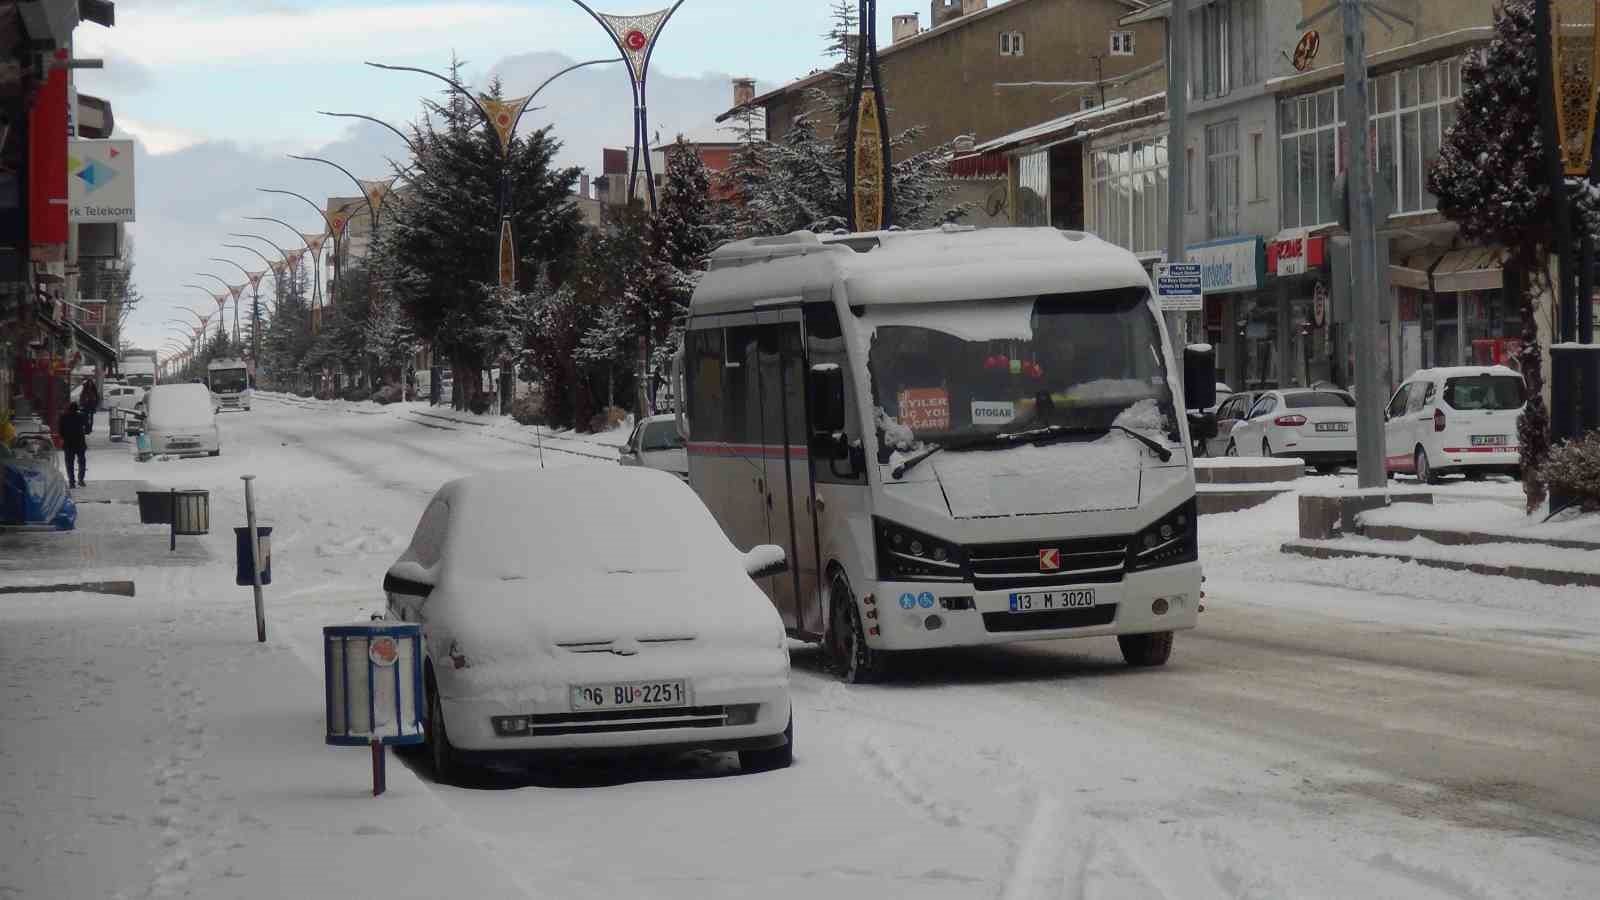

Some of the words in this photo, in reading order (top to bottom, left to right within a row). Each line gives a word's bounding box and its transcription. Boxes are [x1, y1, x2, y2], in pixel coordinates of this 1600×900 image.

[84, 206, 132, 216] Telekom
[975, 407, 1012, 417] OTOGAR
[1018, 594, 1031, 609] 13
[1044, 593, 1053, 609] M
[1061, 591, 1092, 607] 3020
[583, 687, 603, 705] 06
[614, 686, 634, 704] BU
[642, 683, 680, 703] 2251
